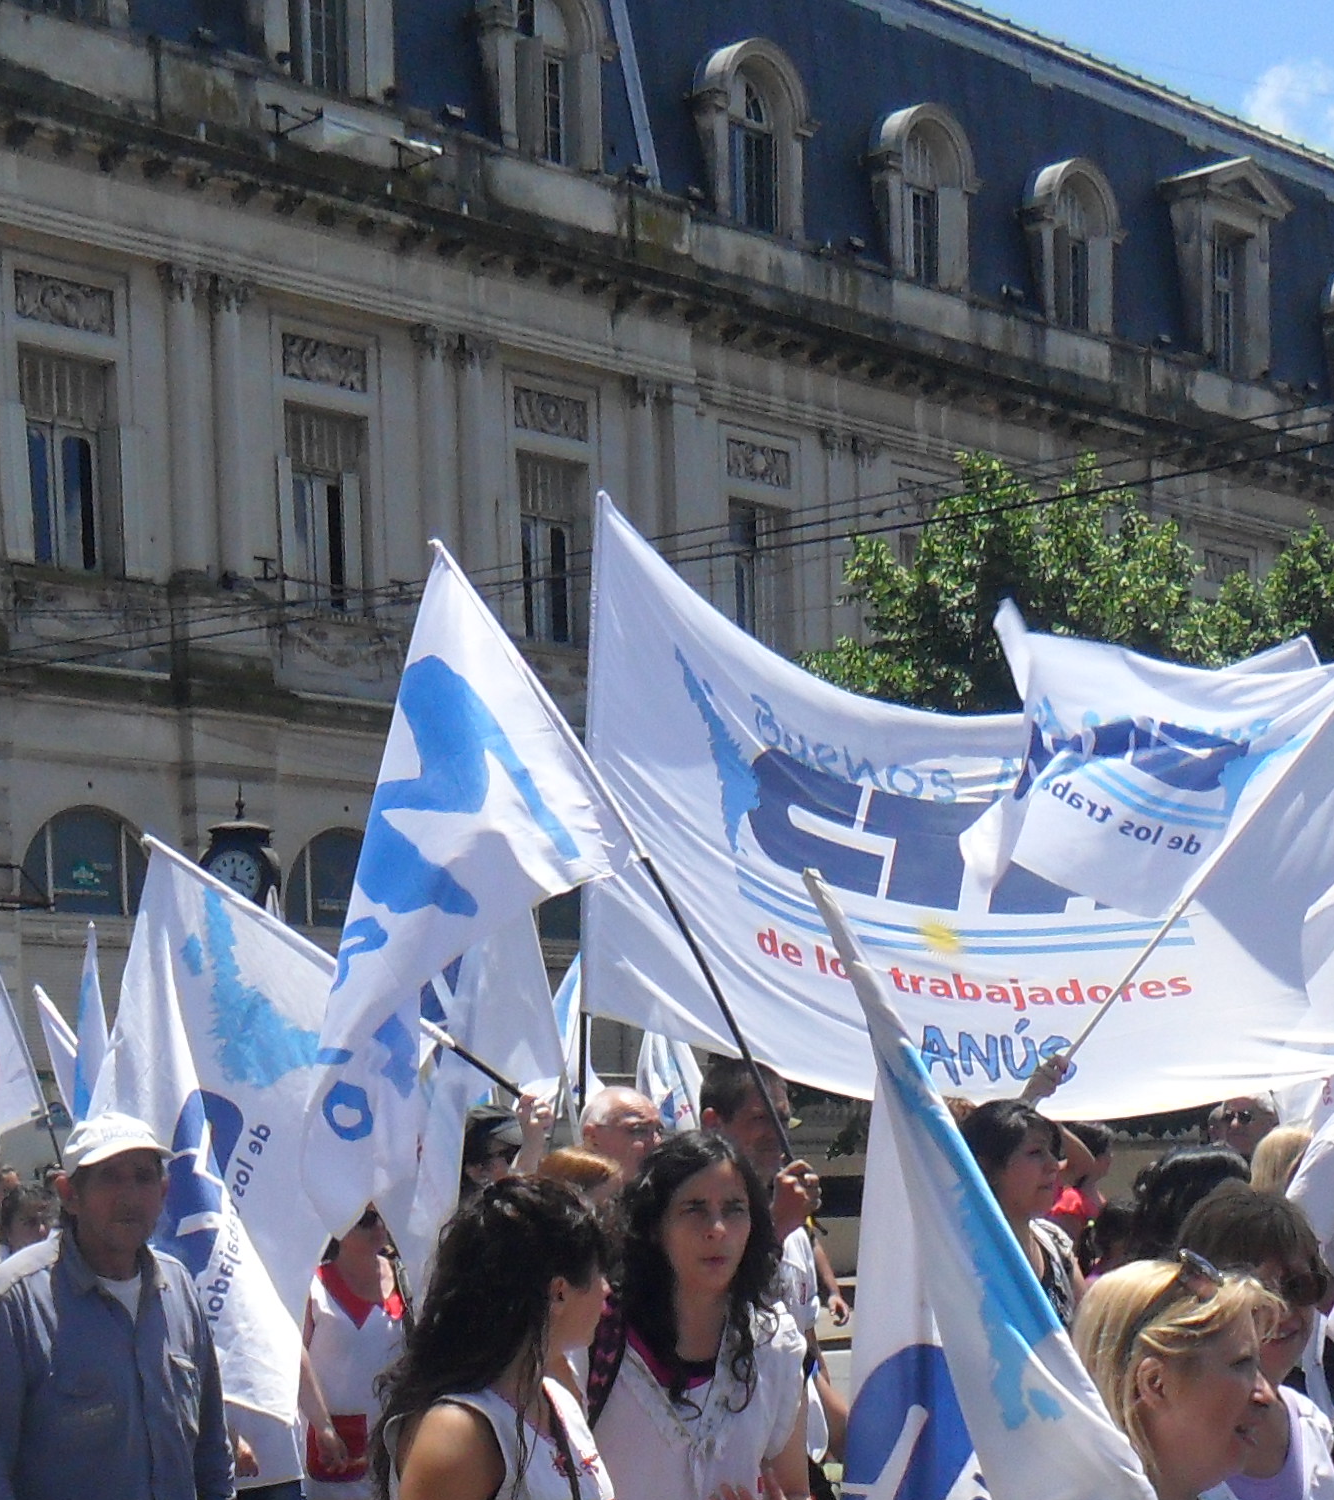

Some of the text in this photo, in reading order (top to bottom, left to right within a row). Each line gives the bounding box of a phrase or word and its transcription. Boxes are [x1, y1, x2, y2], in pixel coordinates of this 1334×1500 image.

[750, 694, 956, 803] Buenos
[756, 928, 1193, 1011] de lo trabajadores
[920, 1017, 1078, 1087] ANÚS
